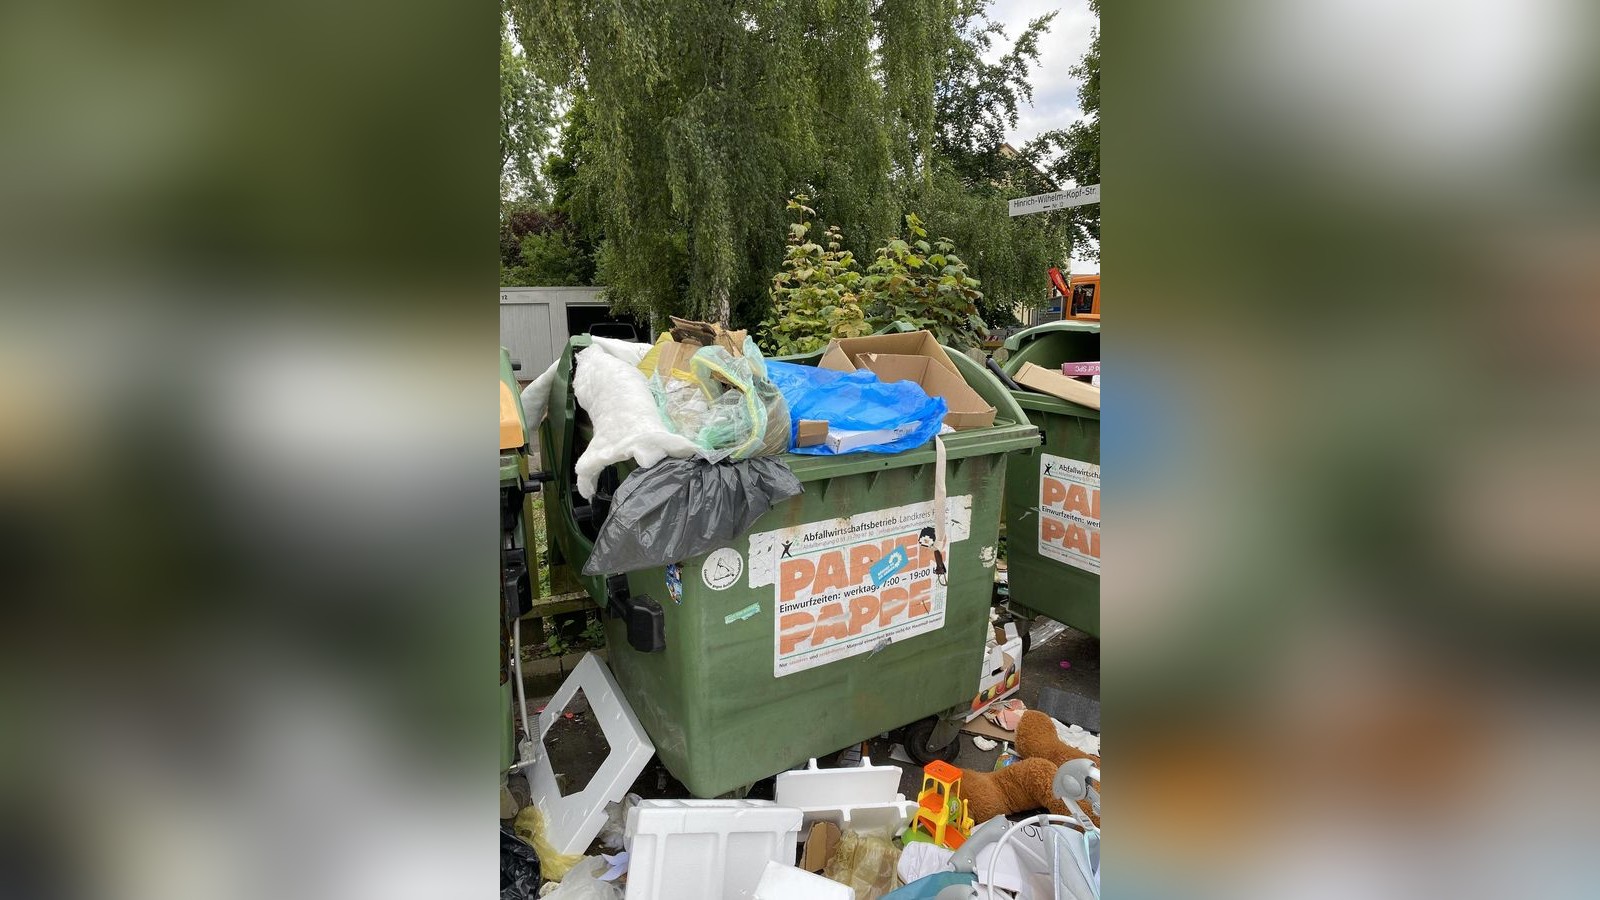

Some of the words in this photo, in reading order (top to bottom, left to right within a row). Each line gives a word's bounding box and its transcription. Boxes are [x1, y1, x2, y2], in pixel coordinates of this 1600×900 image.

[1013, 187, 1097, 208] Hinrich-Wilhelm-Kopf-Str.
[1059, 464, 1100, 479] Abfallwirtsch
[803, 517, 897, 542] Abfallwirtschaftsbetrieb
[899, 511, 931, 524] Landkreis
[1042, 505, 1085, 523] Einwurfzeiten:
[779, 592, 841, 613] Einwurfzeiten:
[909, 568, 931, 580] 19:00
[779, 579, 932, 655] PAPPE
